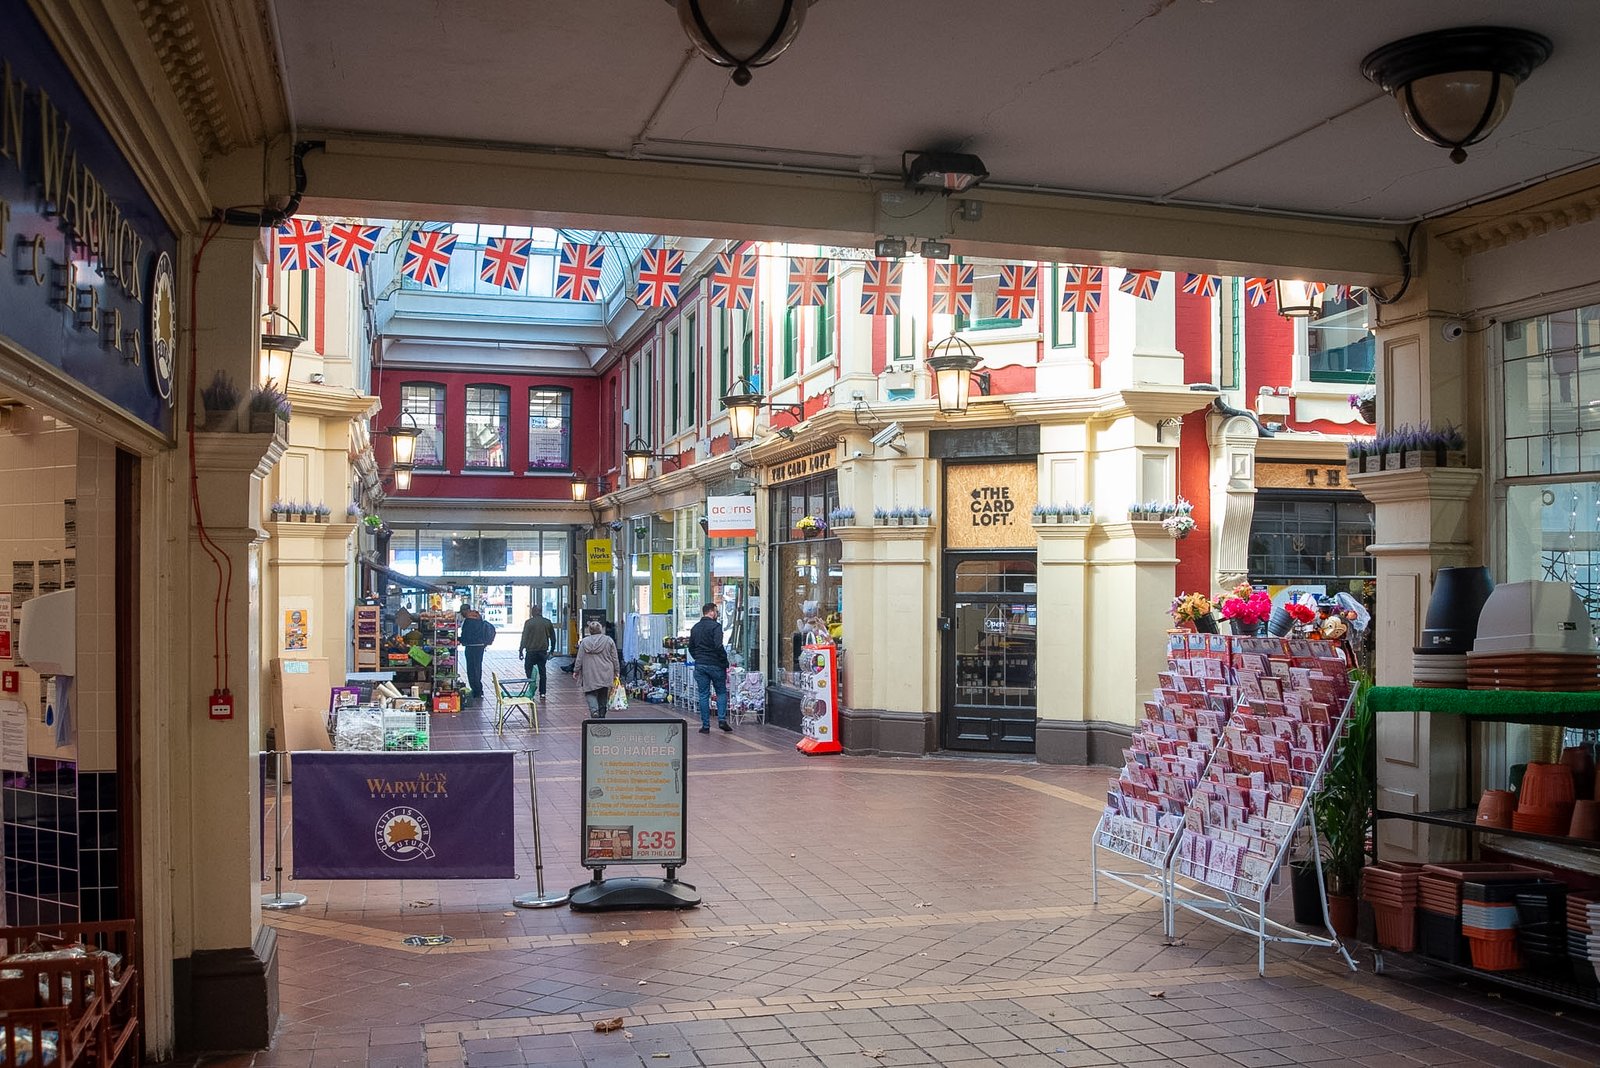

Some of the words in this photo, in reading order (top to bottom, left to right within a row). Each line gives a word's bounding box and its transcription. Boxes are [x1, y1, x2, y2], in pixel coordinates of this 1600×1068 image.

[40, 87, 143, 304] WARWICK
[772, 466, 785, 481] THE
[787, 460, 806, 478] CARD
[810, 453, 830, 472] LOFT
[1306, 469, 1352, 487] TH
[981, 487, 1009, 500] THE
[712, 505, 752, 514] acrns
[971, 500, 1014, 513] CARD
[972, 514, 1013, 526] LOFT.
[985, 619, 1005, 629] Open
[592, 746, 619, 756] BBQ
[623, 746, 676, 756] HAMPER
[418, 772, 448, 780] ALAN
[367, 779, 447, 793] WARWICK
[377, 810, 396, 851] QUALITY
[416, 816, 429, 835] OUR
[391, 840, 430, 853] FUTURE
[637, 831, 676, 850] £35
